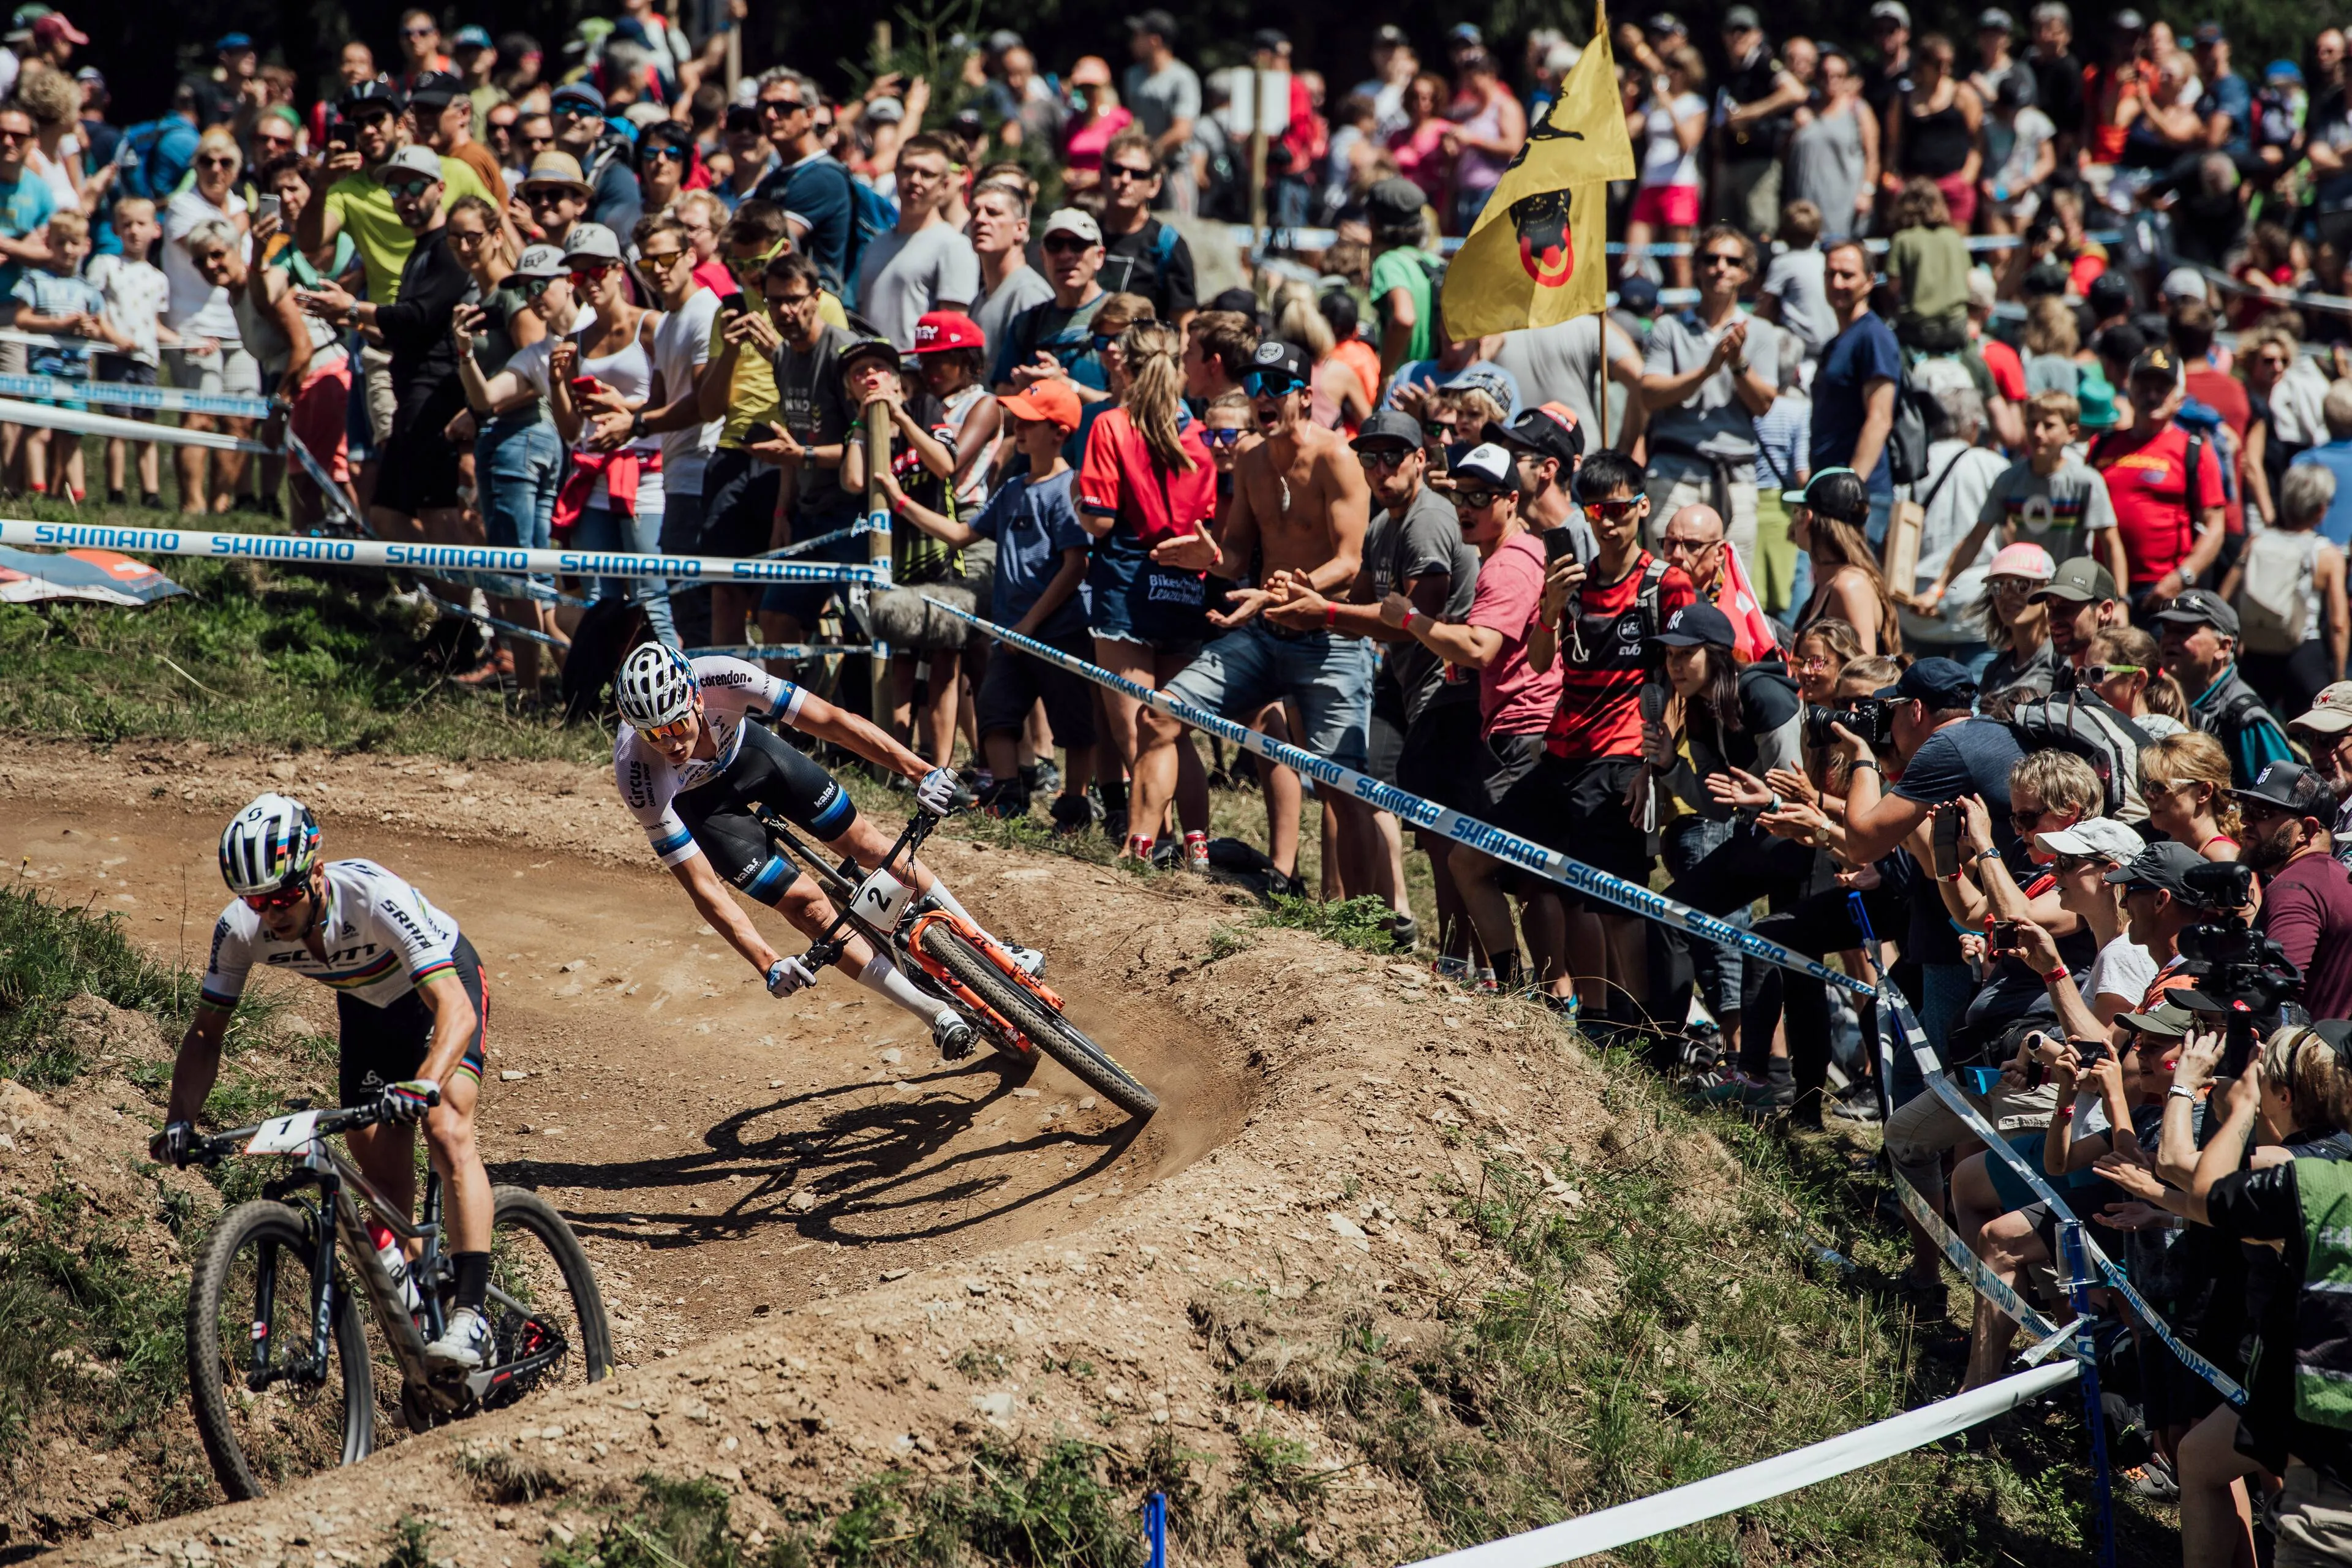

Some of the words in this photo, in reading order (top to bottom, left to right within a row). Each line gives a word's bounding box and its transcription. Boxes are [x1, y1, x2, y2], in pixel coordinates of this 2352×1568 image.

[35, 524, 179, 551] SHIMANO
[211, 535, 355, 561] SHIMANO
[385, 545, 528, 570] SHIMANO
[560, 554, 701, 577] SHIMANO
[628, 760, 646, 809] Circus
[813, 781, 835, 809] kalas
[1168, 699, 1249, 745] SHIMANO
[1261, 737, 1344, 785] SHIMANO
[1355, 777, 1442, 826] SHIMANO
[1450, 816, 1549, 871] SHIMANO
[1565, 862, 1666, 919] SHIMANO
[733, 858, 759, 883] kalas
[867, 887, 892, 913] 2
[380, 899, 433, 949] SRAM
[267, 943, 378, 963] SCTT
[279, 1118, 293, 1136] 1
